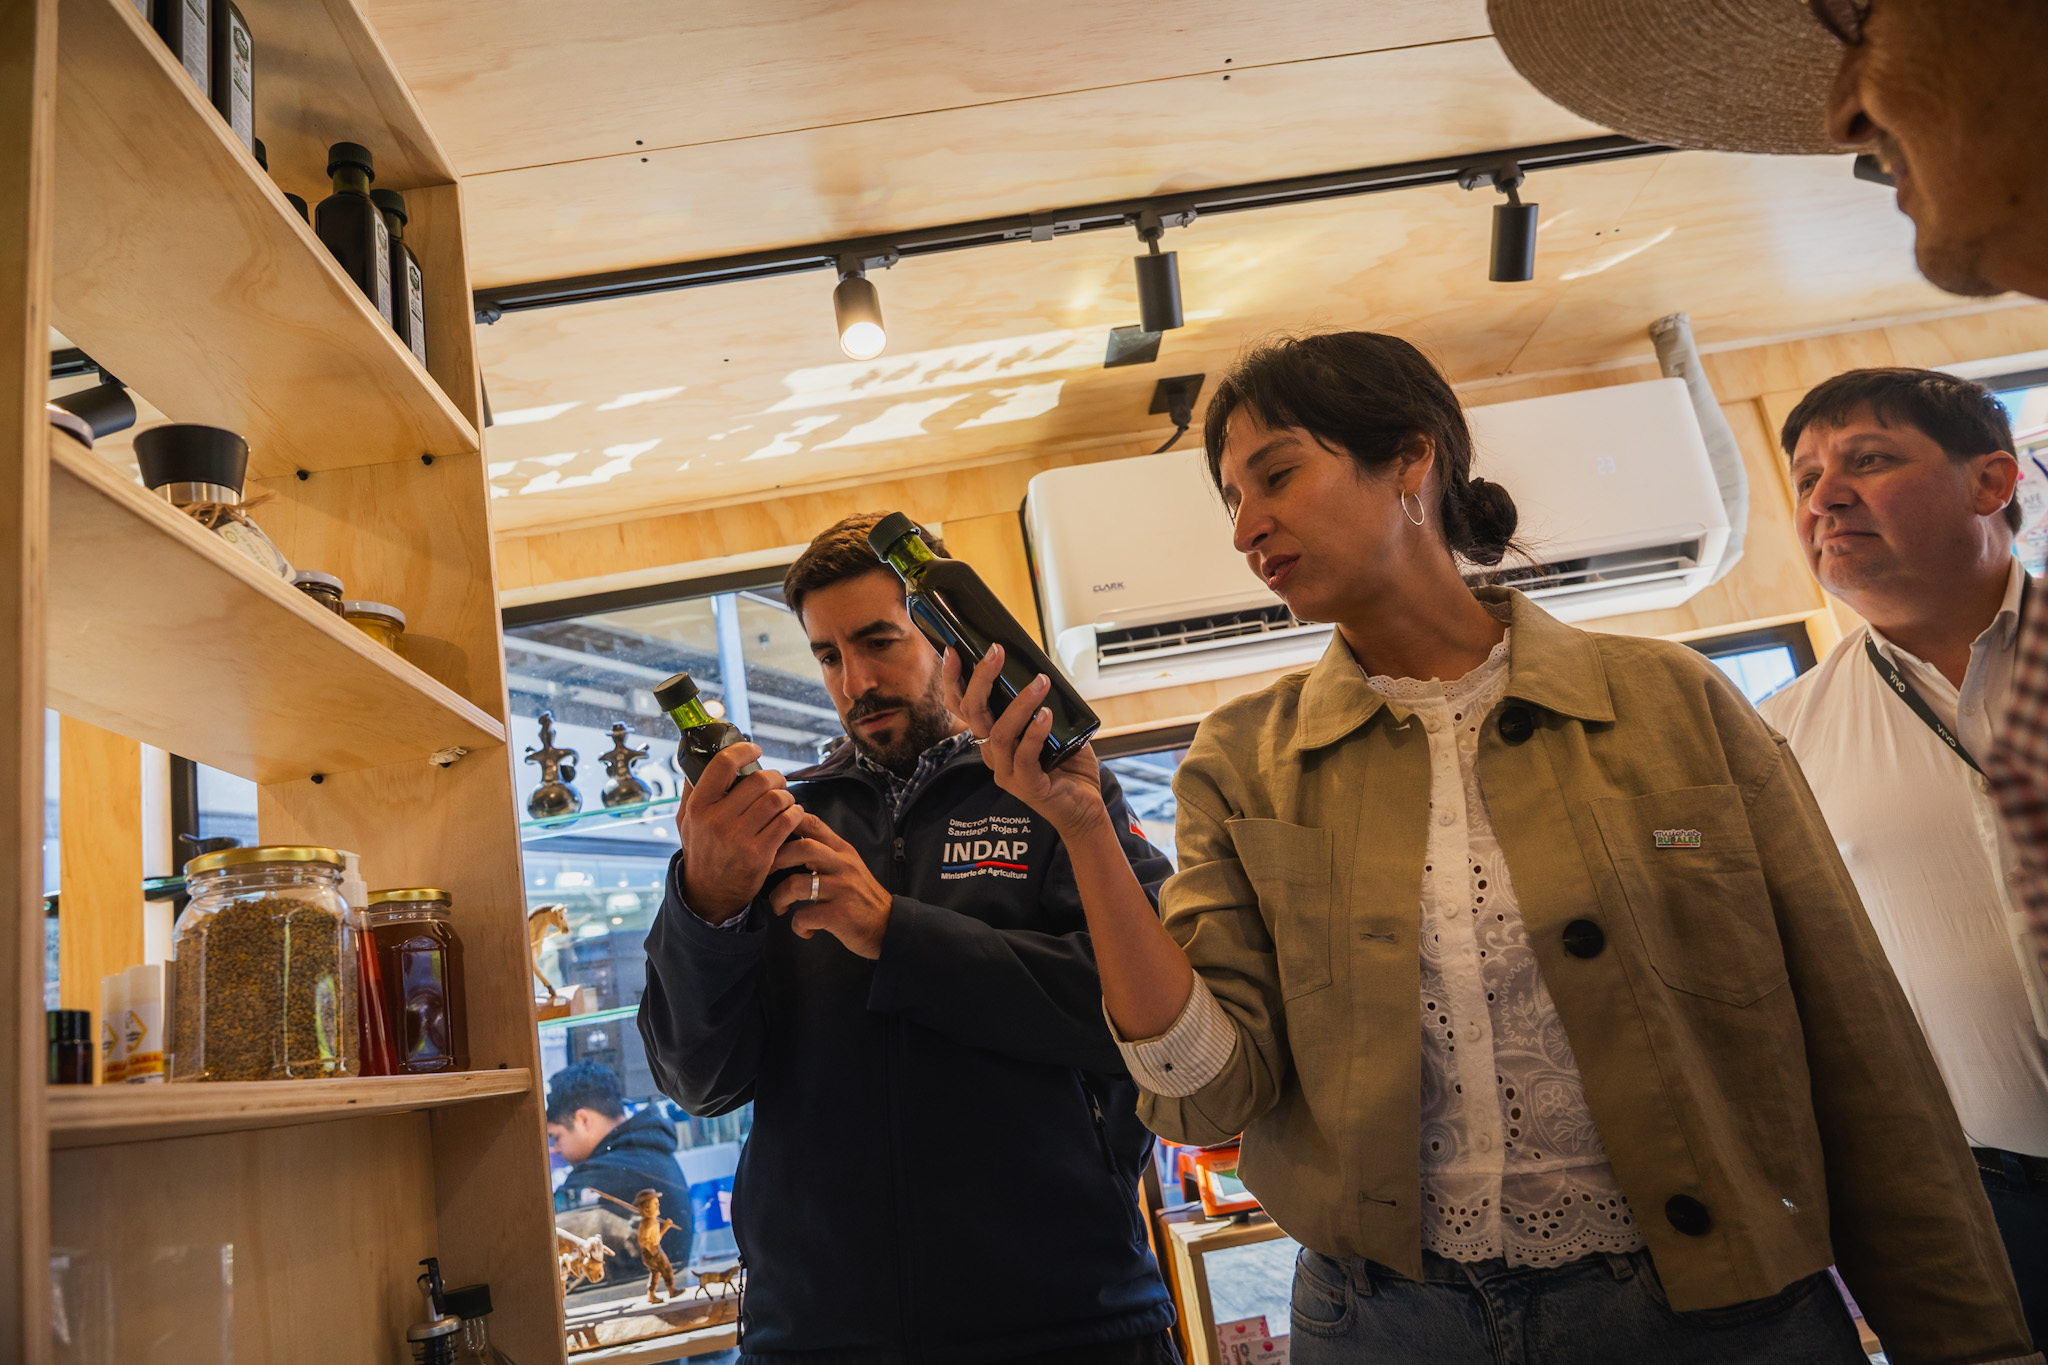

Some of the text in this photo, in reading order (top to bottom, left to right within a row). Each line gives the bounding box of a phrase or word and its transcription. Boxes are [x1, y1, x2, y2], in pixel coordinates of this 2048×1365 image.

[1093, 582, 1125, 593] CLARK
[1889, 670, 1906, 693] VIVO
[1937, 724, 1956, 747] VIVO
[949, 816, 1031, 828] DIRECTOR NACIONAL
[948, 824, 1031, 836] Santiago Rojas A.
[943, 840, 1028, 863] INDAP
[941, 867, 1028, 880] Ministerio de Agricultura
